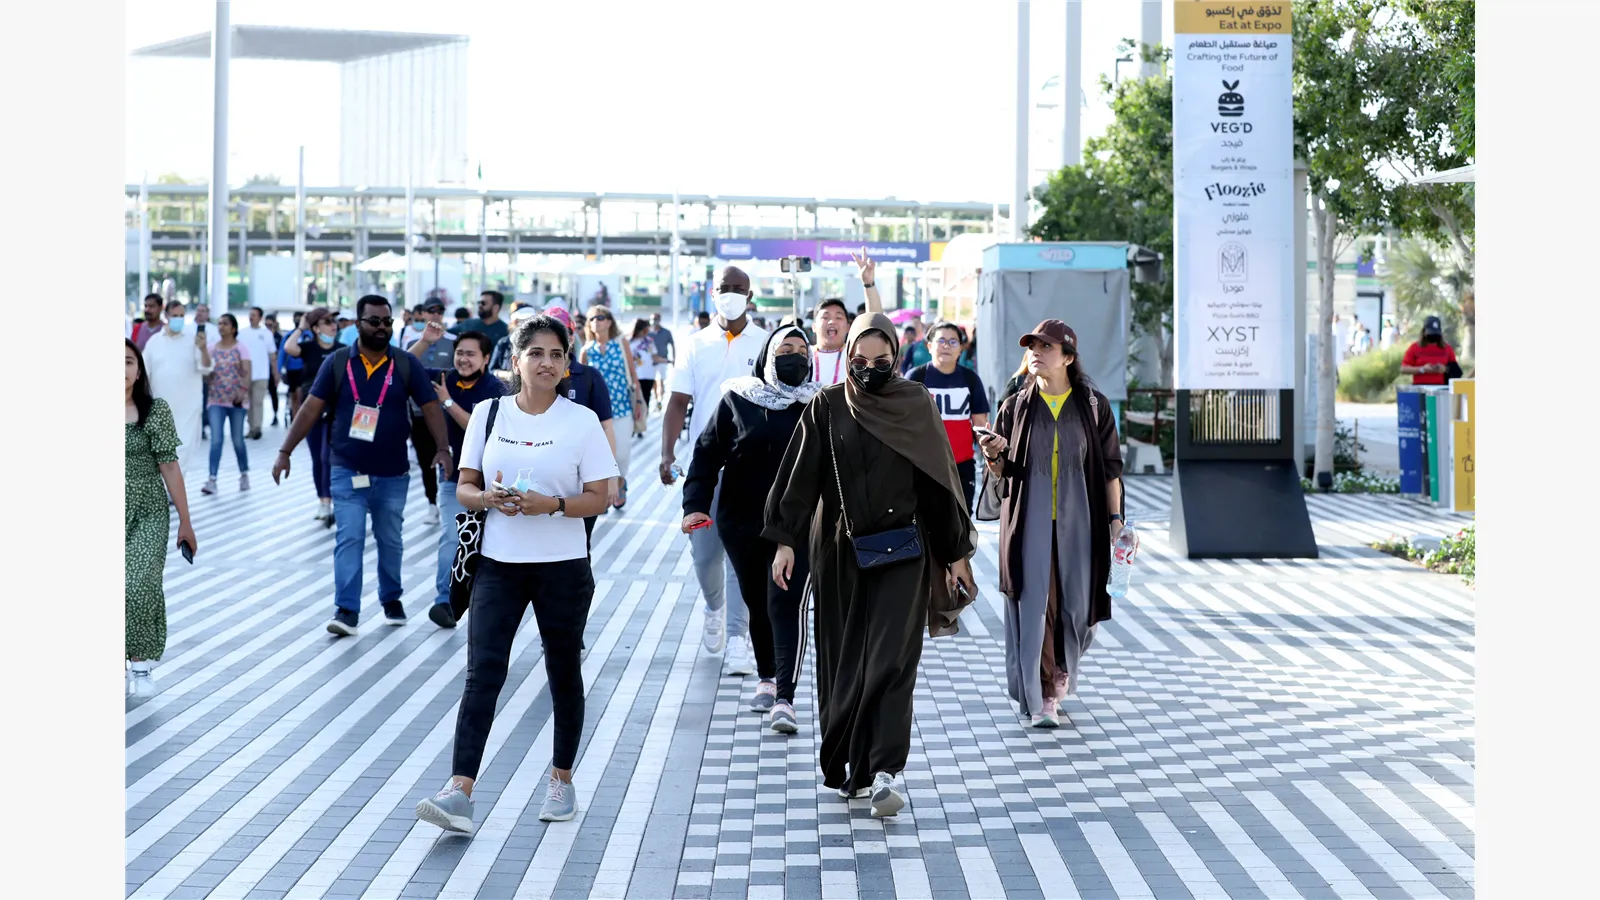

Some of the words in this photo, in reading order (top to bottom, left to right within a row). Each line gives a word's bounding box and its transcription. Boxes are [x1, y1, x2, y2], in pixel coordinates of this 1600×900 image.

[1206, 6, 1235, 18] إكسبو
[1237, 6, 1254, 19] في
[1257, 6, 1282, 18] تذوّق
[1219, 20, 1238, 30] Eat
[1240, 21, 1252, 30] at
[1254, 20, 1282, 32] Expo
[1188, 40, 1217, 50] الطعام
[1219, 40, 1251, 50] مستقبل
[1253, 40, 1278, 49] صياغة
[1187, 53, 1222, 63] Crafting
[1223, 53, 1237, 61] the
[1239, 53, 1267, 61] Future
[1268, 53, 1278, 61] of
[1221, 64, 1244, 72] Food
[1210, 122, 1253, 134] VEG'D
[1204, 181, 1266, 201] Floozie
[1222, 212, 1249, 224] فلوزي
[1207, 326, 1260, 342] XYST
[498, 436, 519, 445] TOMMY
[534, 440, 554, 448] JEANS
